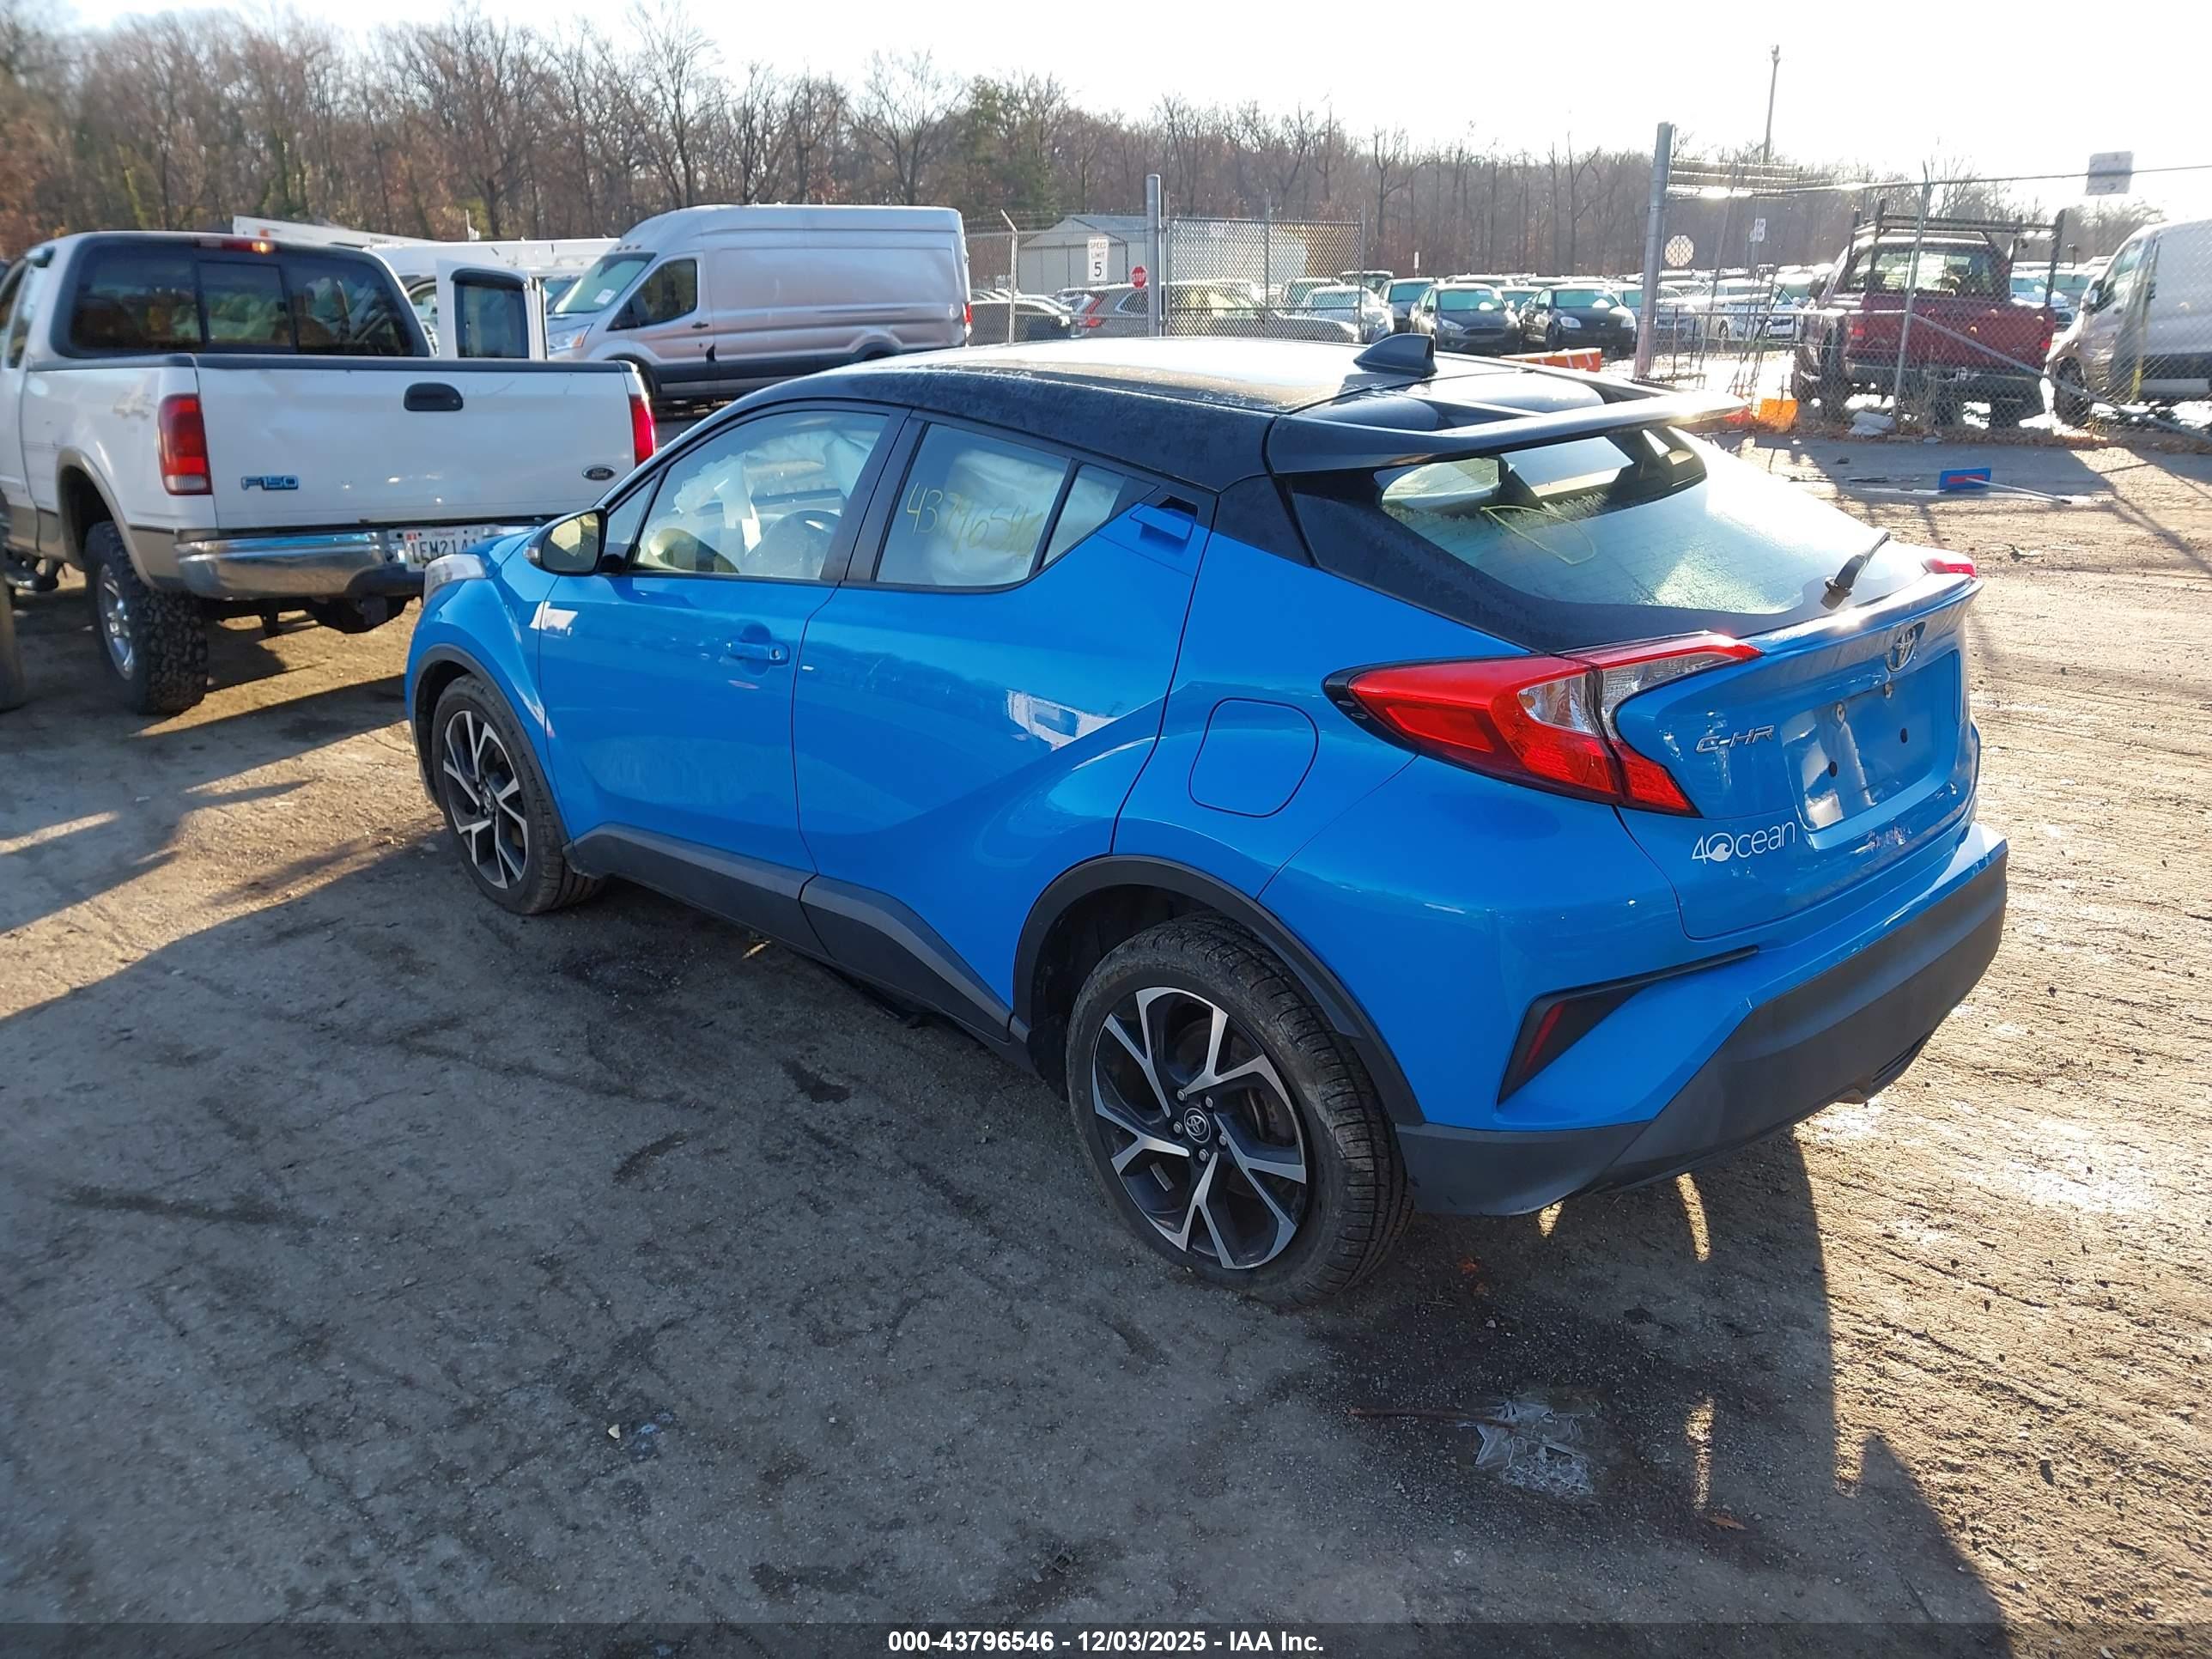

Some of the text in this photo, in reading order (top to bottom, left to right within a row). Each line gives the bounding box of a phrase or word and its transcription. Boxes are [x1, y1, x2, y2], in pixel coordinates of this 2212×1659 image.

[1091, 251, 1105, 259] LIMIT
[1094, 261, 1103, 277] 5
[1132, 272, 1146, 283] STOP
[1695, 725, 1775, 753] C-HR
